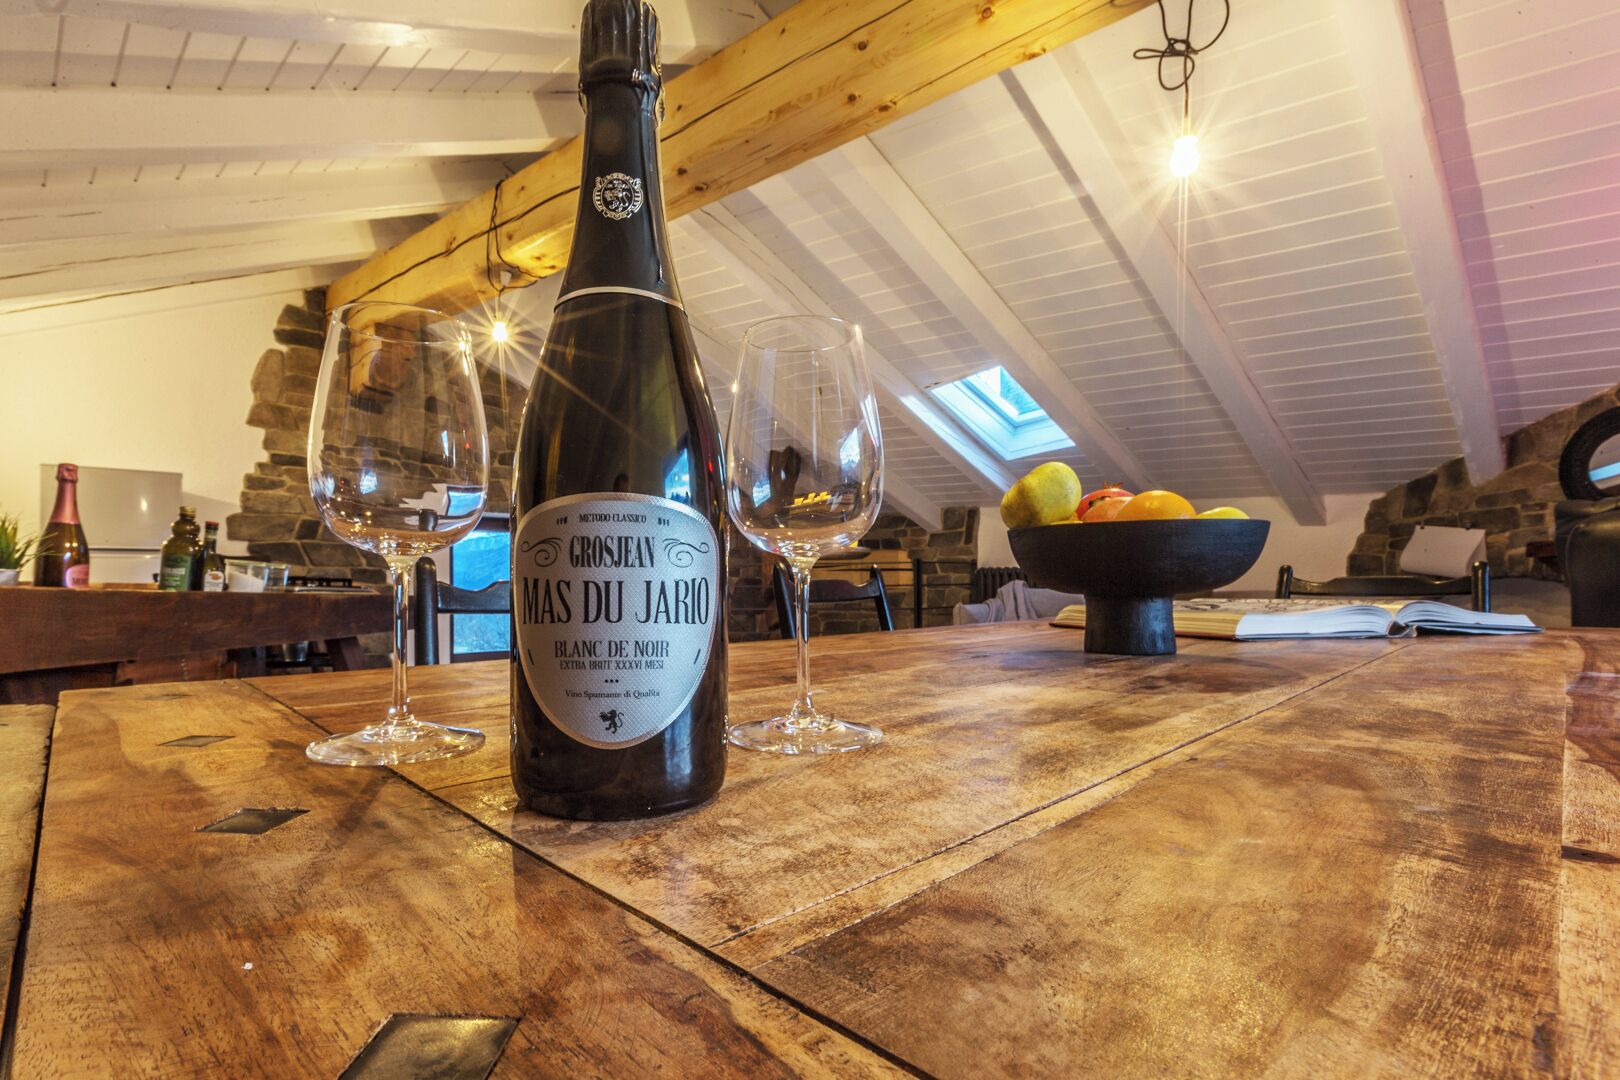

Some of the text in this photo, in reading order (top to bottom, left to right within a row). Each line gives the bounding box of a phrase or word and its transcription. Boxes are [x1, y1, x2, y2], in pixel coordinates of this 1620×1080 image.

[579, 513, 647, 524] METODO CLASSICO
[569, 535, 655, 568] GROSJEAN
[523, 577, 710, 625] MAS DU JARIO
[554, 640, 670, 658] BLANC DE NOIR
[559, 659, 664, 670] EXTRA BRUT XXXVI MESI
[565, 690, 582, 698] Vino
[583, 690, 622, 700] Spumante
[623, 690, 632, 698] di
